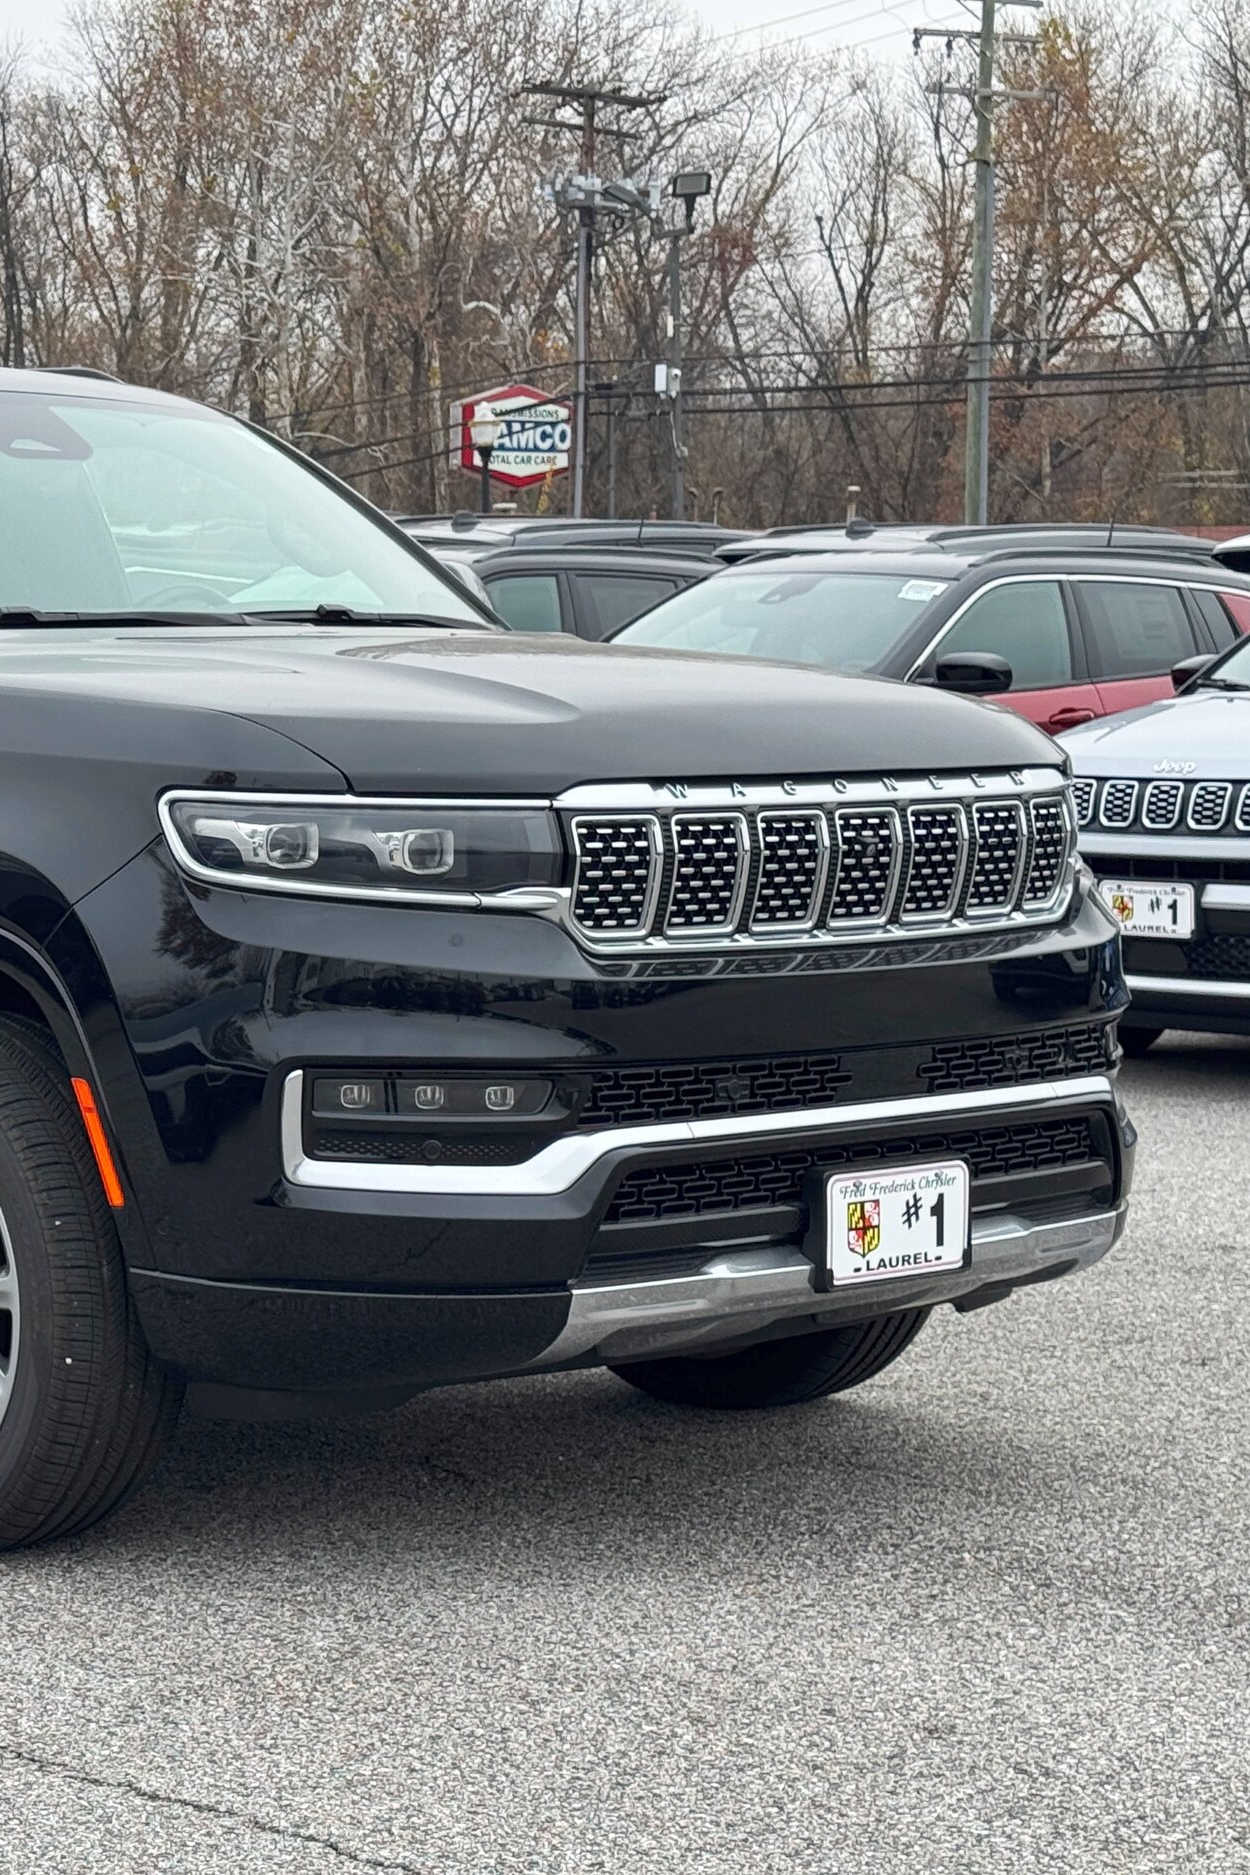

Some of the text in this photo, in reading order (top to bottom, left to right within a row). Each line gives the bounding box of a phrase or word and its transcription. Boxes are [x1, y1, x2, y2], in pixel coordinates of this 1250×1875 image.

[493, 422, 571, 450] AMCO
[489, 455, 512, 466] OTAL
[514, 455, 532, 466] CAR
[1153, 758, 1196, 774] Jeep
[664, 770, 1032, 799] WAGONEER
[839, 1174, 957, 1199] Fred Frederick Chrysler
[866, 1251, 933, 1272] LAUREL
